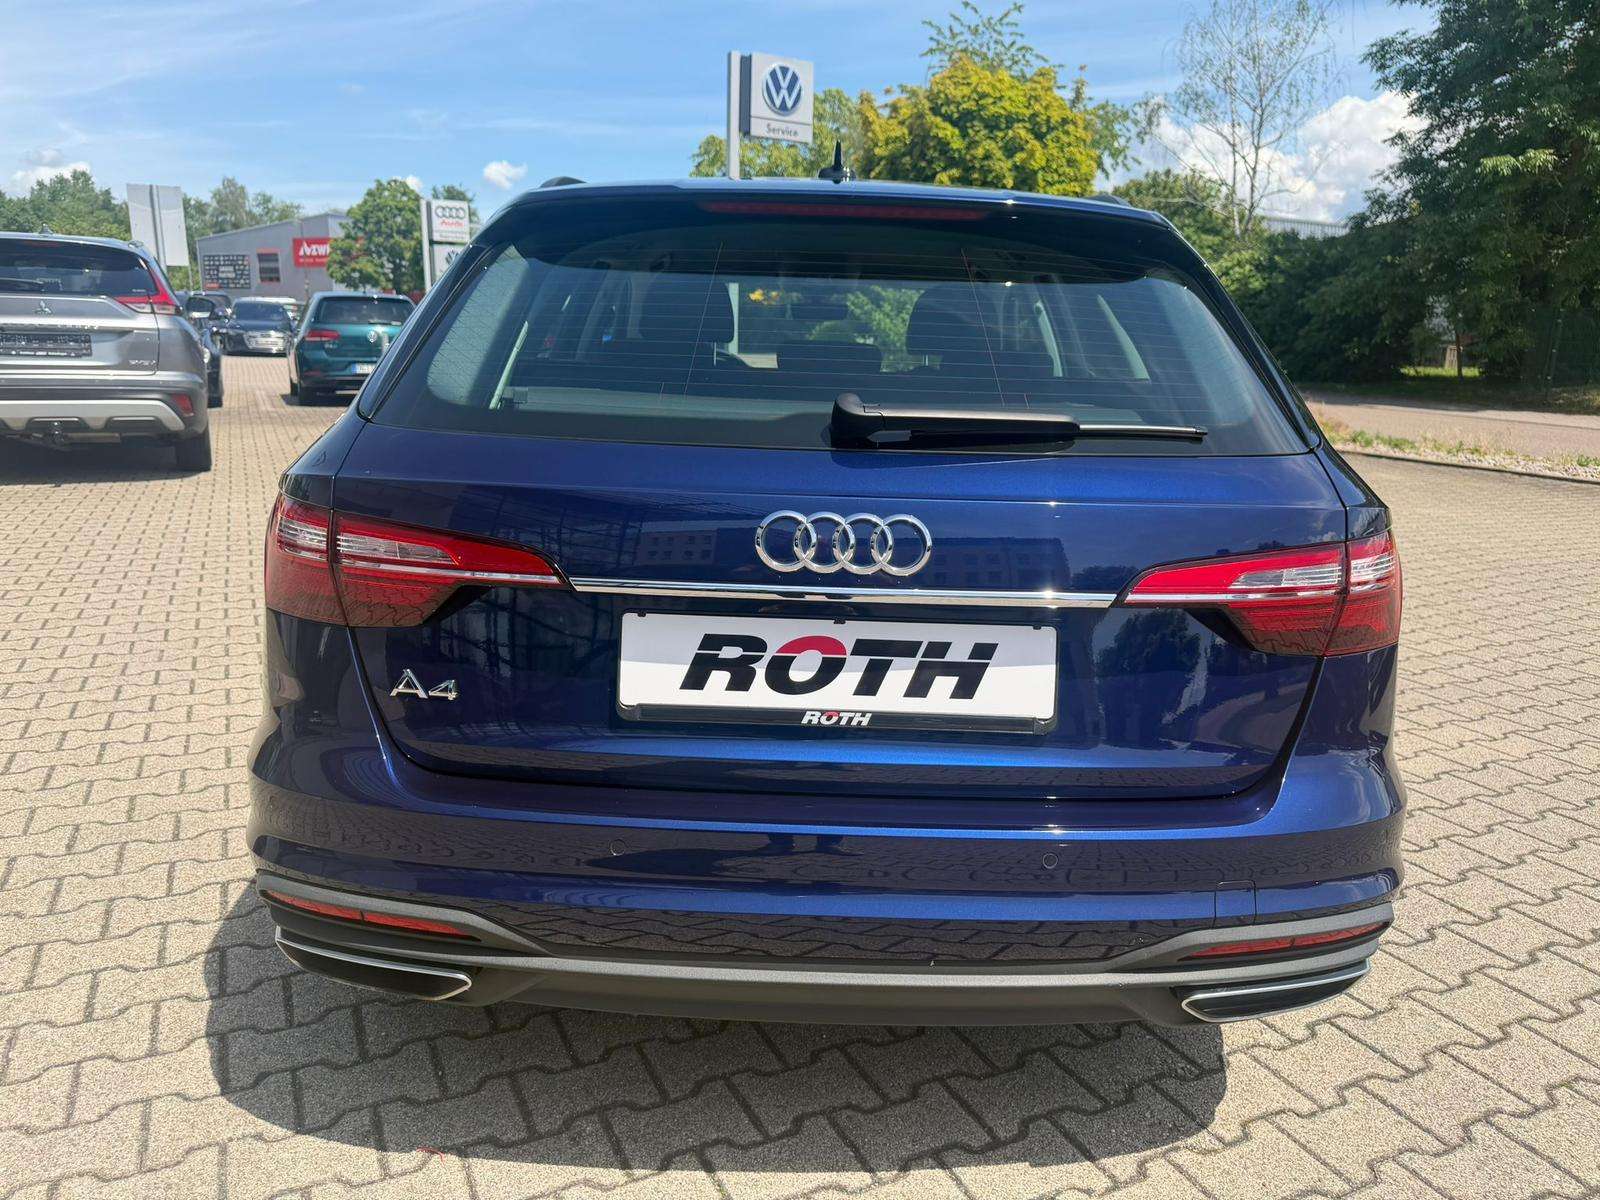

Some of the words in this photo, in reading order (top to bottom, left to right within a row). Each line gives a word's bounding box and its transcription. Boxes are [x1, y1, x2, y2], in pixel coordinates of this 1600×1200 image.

[766, 122, 799, 137] Service
[680, 633, 998, 700] ROTH
[389, 668, 458, 700] A4
[801, 710, 872, 727] ROTH
